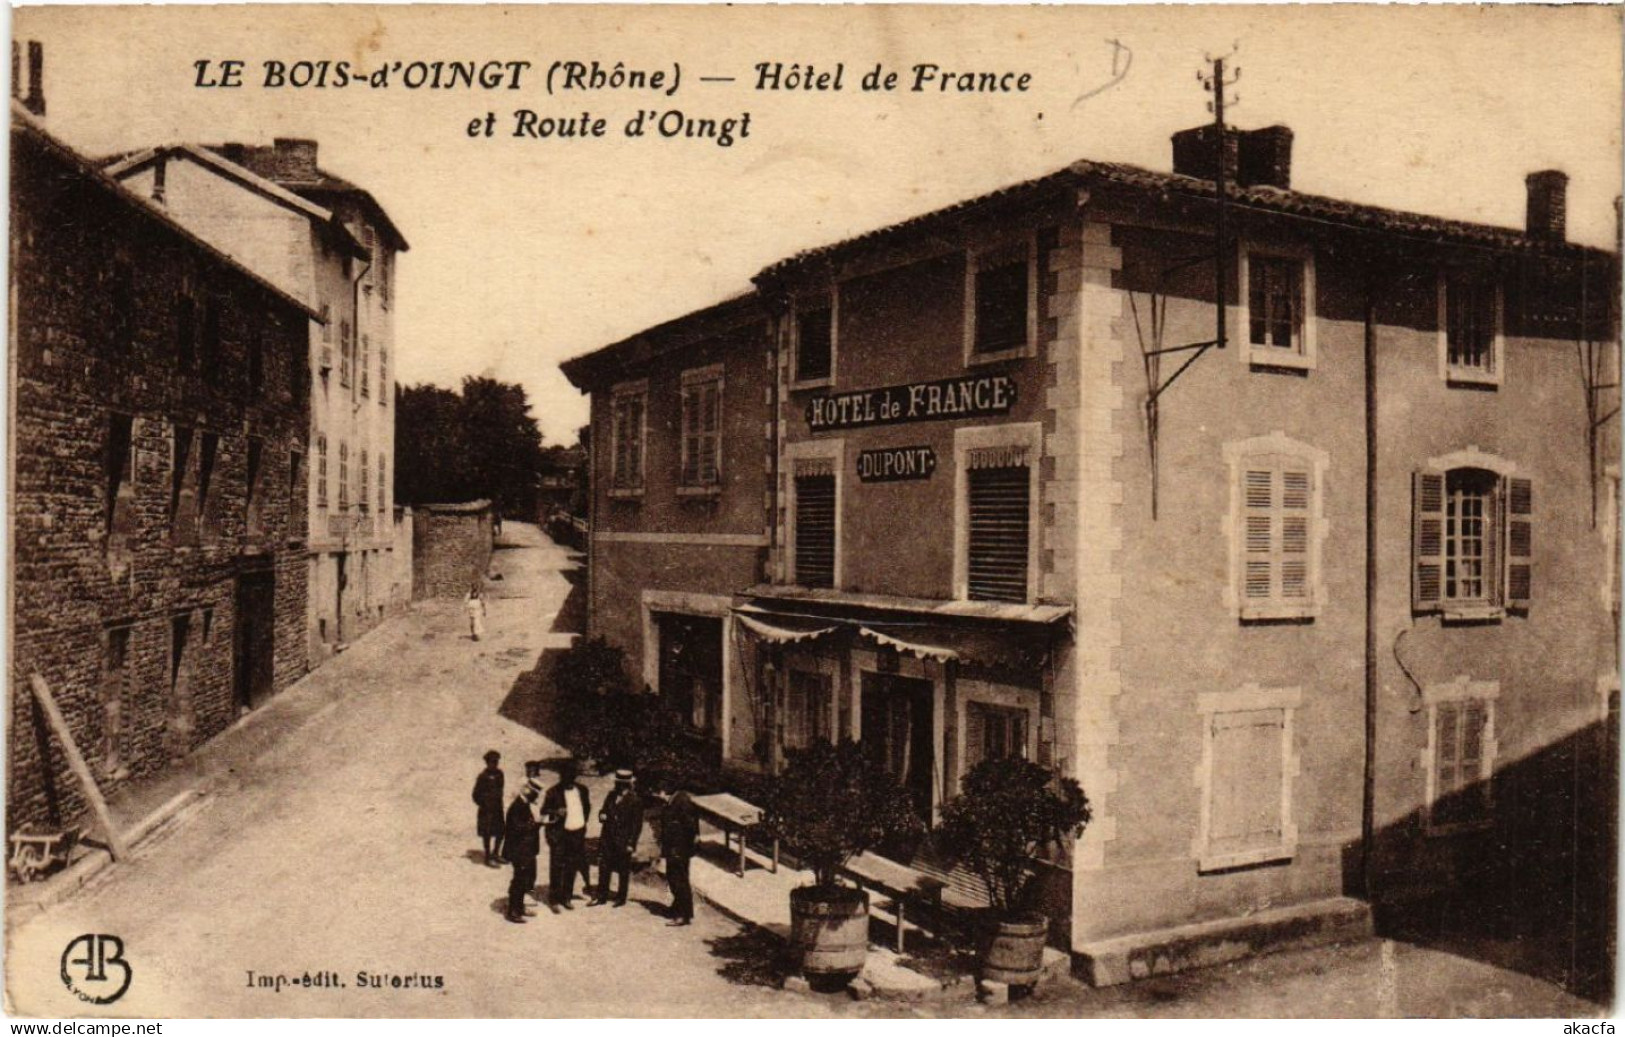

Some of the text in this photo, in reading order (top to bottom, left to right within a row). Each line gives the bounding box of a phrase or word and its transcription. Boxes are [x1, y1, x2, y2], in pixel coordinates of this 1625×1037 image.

[879, 390, 901, 420] de
[907, 376, 1009, 416] FRANCE
[861, 449, 931, 478] DUPONT
